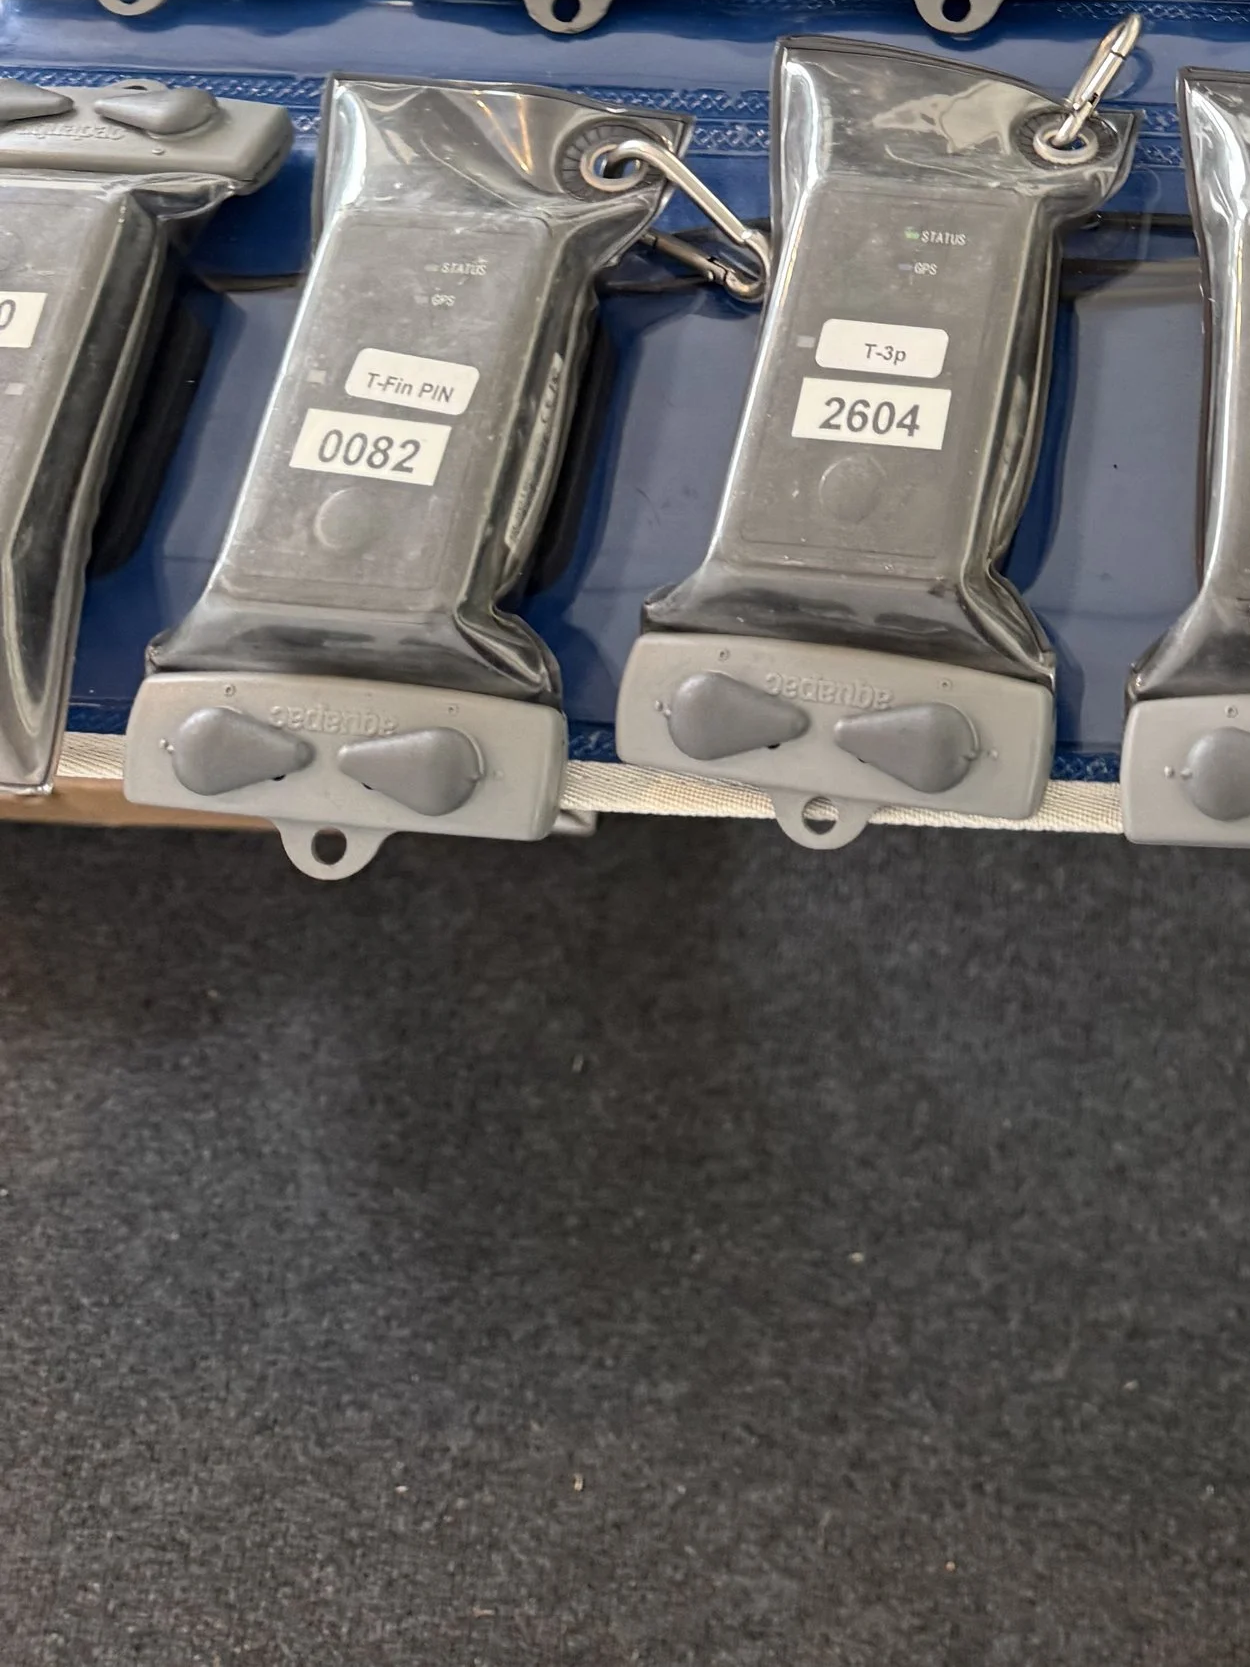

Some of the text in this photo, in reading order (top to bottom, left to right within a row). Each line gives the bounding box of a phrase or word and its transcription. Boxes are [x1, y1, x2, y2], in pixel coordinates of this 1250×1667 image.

[920, 231, 968, 247] STATUS
[440, 261, 488, 276] STATUS
[913, 261, 938, 276] GPS
[431, 293, 456, 308] GPS
[864, 342, 907, 366] T-3p
[367, 372, 455, 404] T-Fin PIN
[818, 396, 921, 437] 2604
[318, 428, 422, 474] 0082
